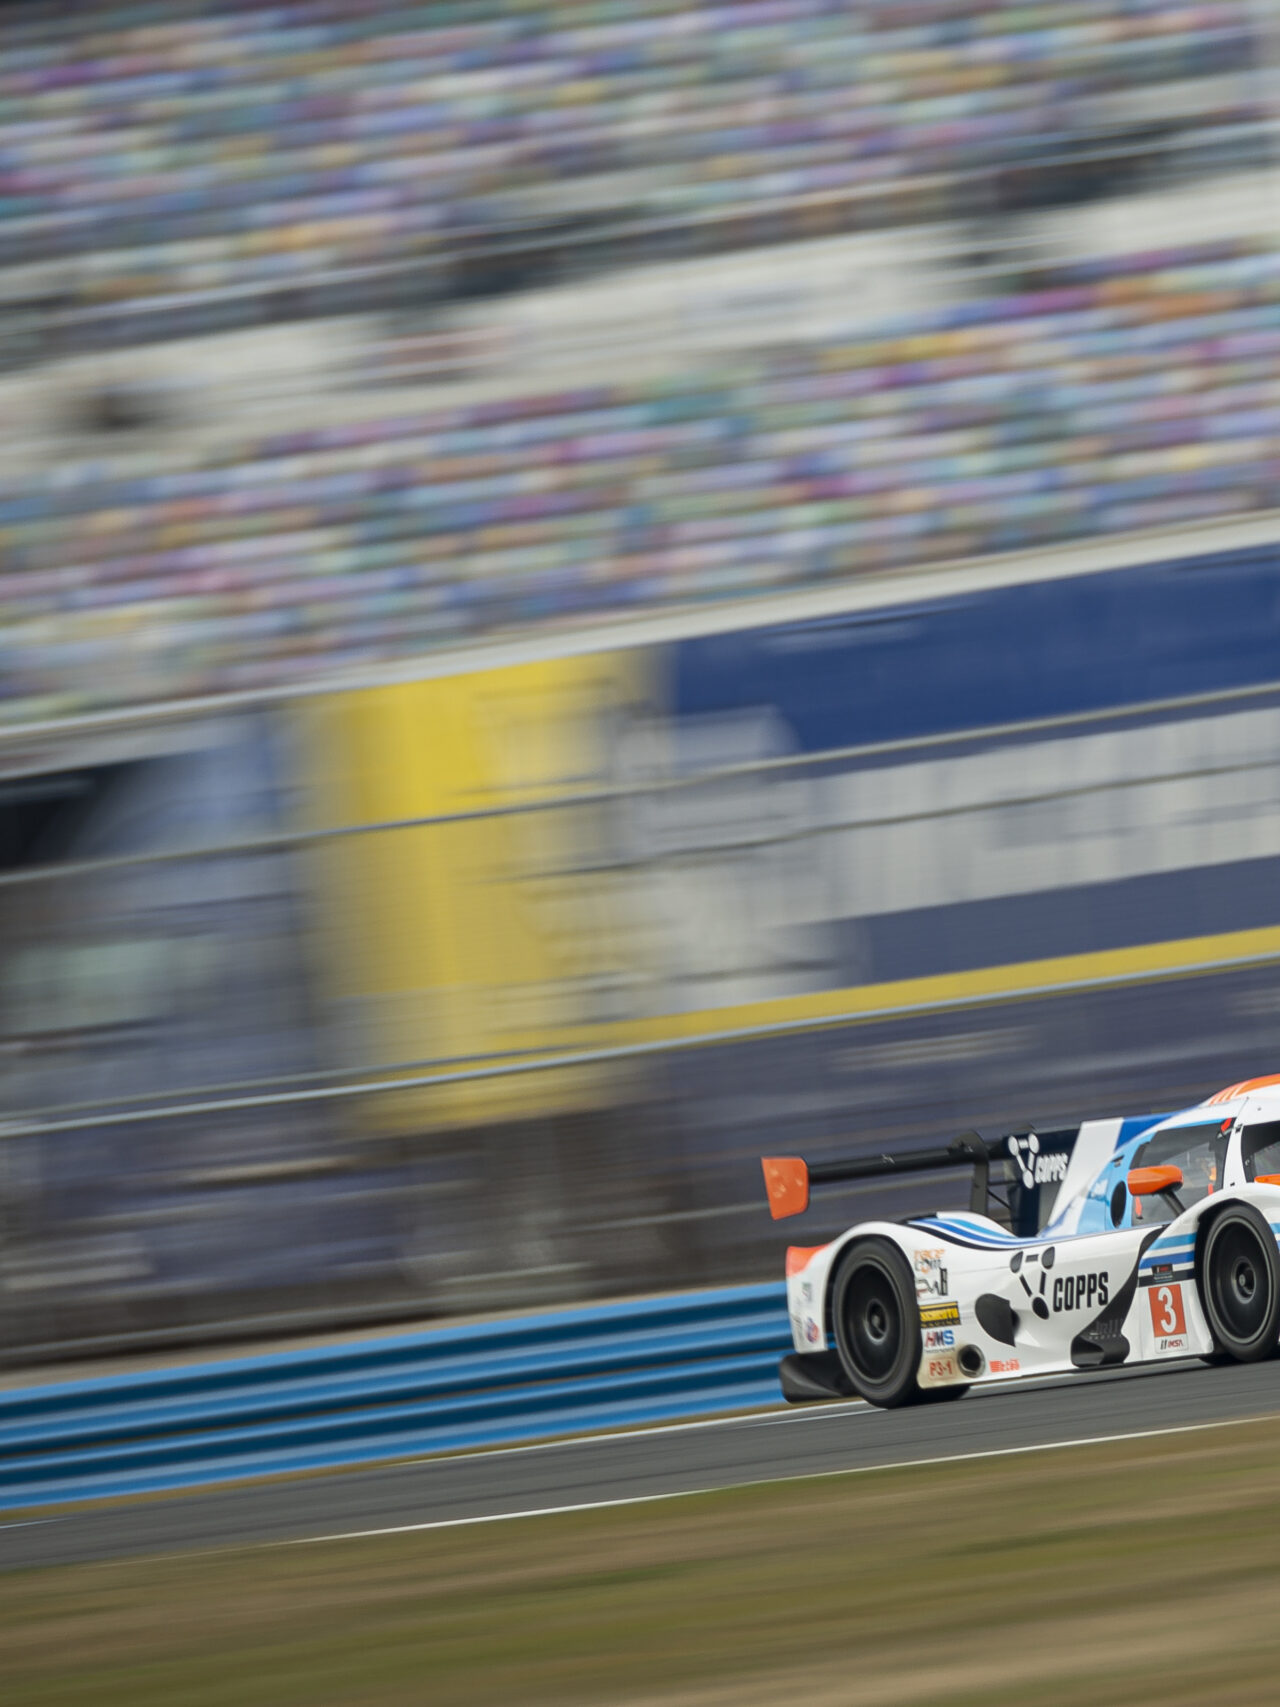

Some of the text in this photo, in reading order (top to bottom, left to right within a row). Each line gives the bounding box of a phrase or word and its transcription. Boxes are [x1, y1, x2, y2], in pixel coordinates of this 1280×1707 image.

[1034, 1152, 1069, 1184] COPPS
[1053, 1271, 1109, 1313] COPPS
[1158, 1286, 1177, 1333] 3
[925, 1330, 956, 1348] HMS
